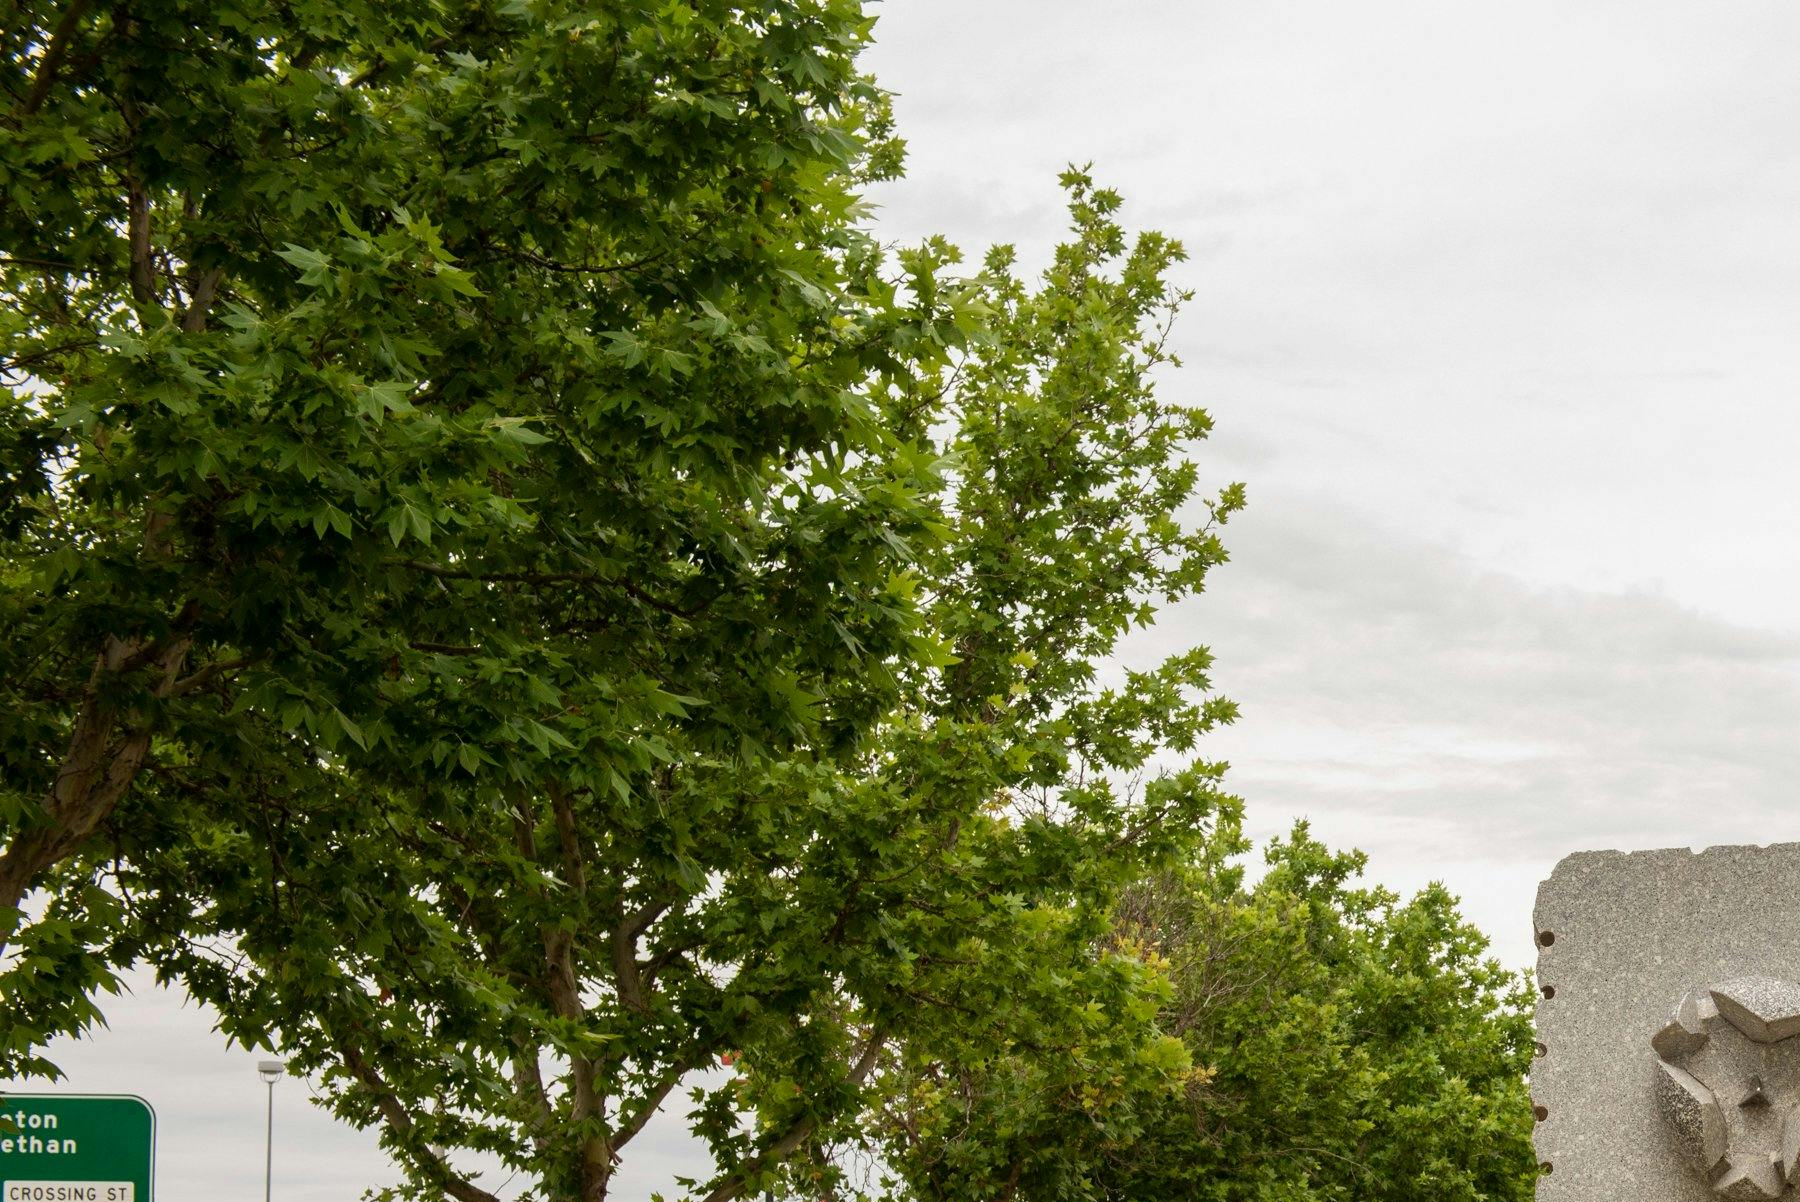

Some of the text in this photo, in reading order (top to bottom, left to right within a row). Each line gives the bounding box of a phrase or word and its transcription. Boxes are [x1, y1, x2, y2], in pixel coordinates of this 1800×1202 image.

[1, 1135, 77, 1154] ethan
[9, 1187, 127, 1201] CROSSING ST
